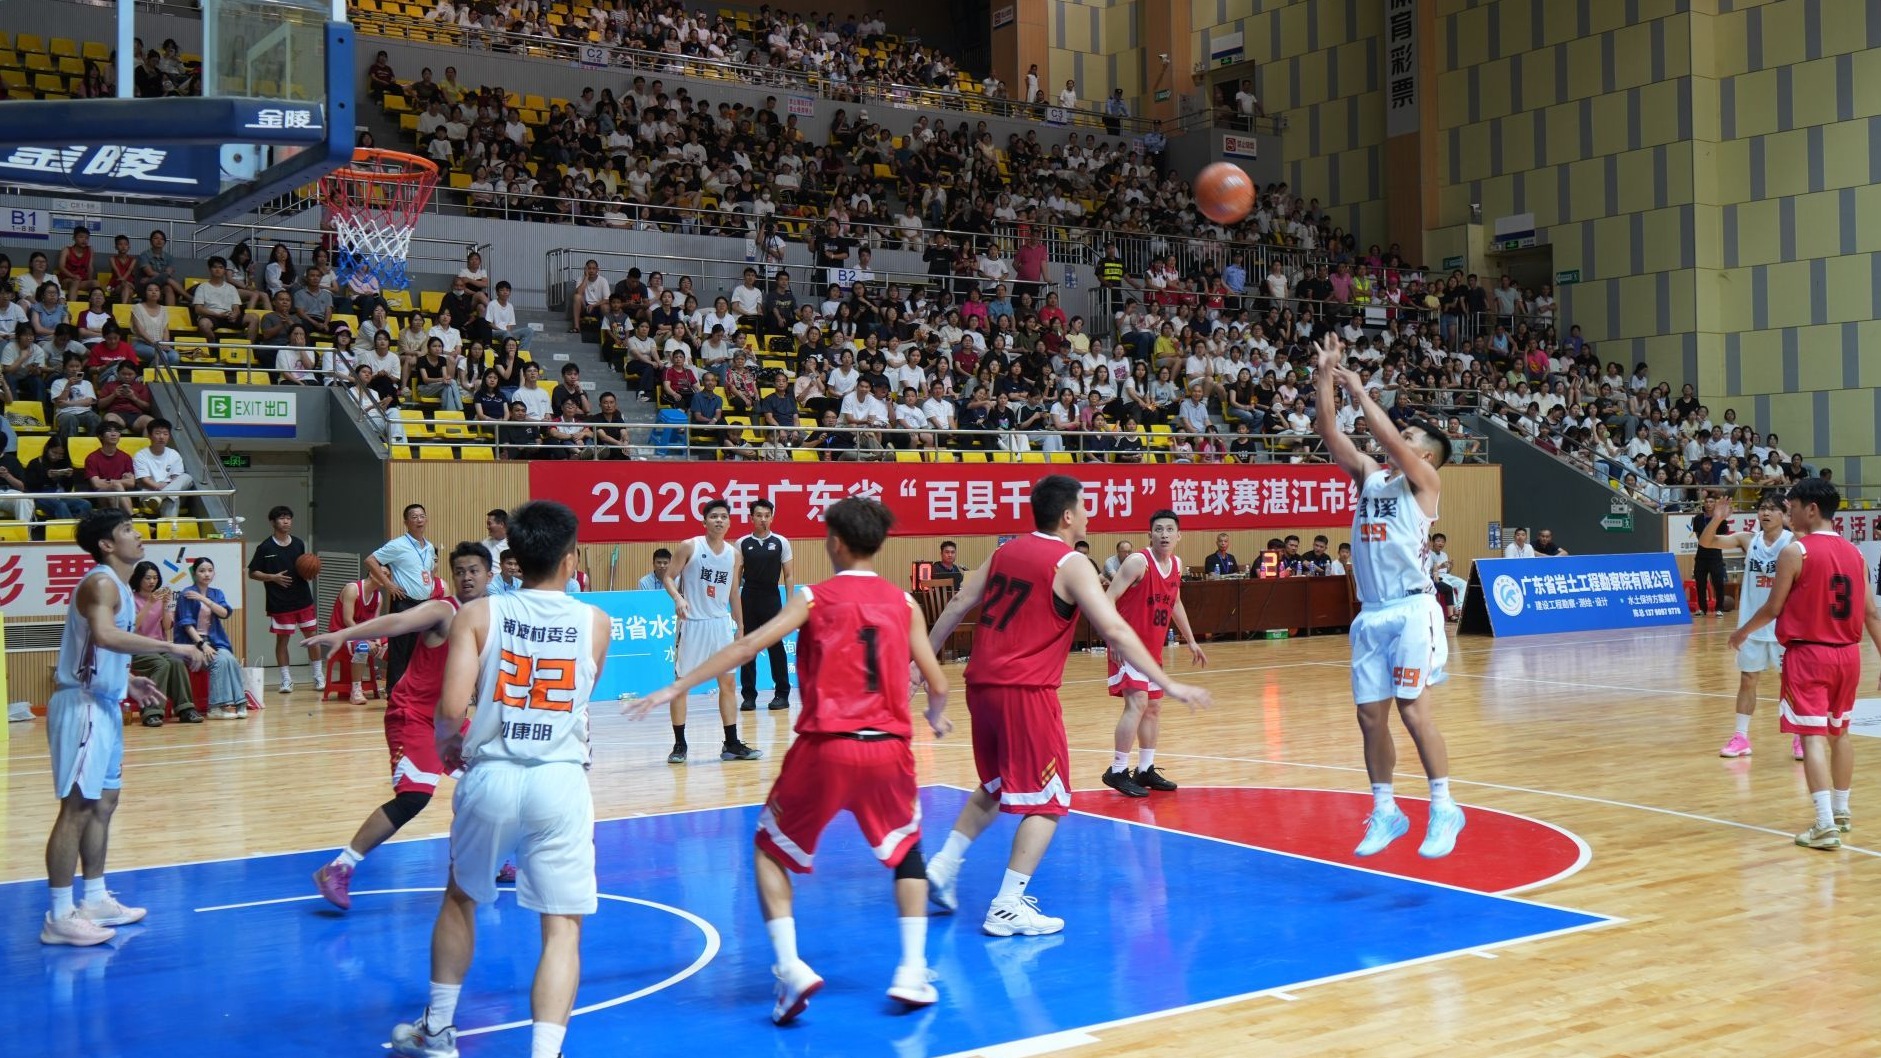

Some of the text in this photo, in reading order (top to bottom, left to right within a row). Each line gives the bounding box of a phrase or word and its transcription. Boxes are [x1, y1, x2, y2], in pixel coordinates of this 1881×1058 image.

[587, 48, 603, 58] C2
[258, 108, 311, 128] 金陵
[1051, 108, 1063, 118] C3
[7, 145, 167, 177] 金陵
[12, 210, 36, 225] B1
[838, 270, 856, 281] B2
[235, 400, 288, 417] EXIT 出口
[1264, 552, 1278, 577] 2
[700, 566, 728, 585] 遂溪
[1520, 571, 1673, 595] 广东省岩土工程勘察院有限公司
[979, 571, 1033, 632] 27
[1830, 573, 1854, 620] 3
[1152, 608, 1168, 627] 88
[857, 627, 879, 692] 1
[493, 648, 577, 713] 22
[1392, 666, 1420, 688] 99
